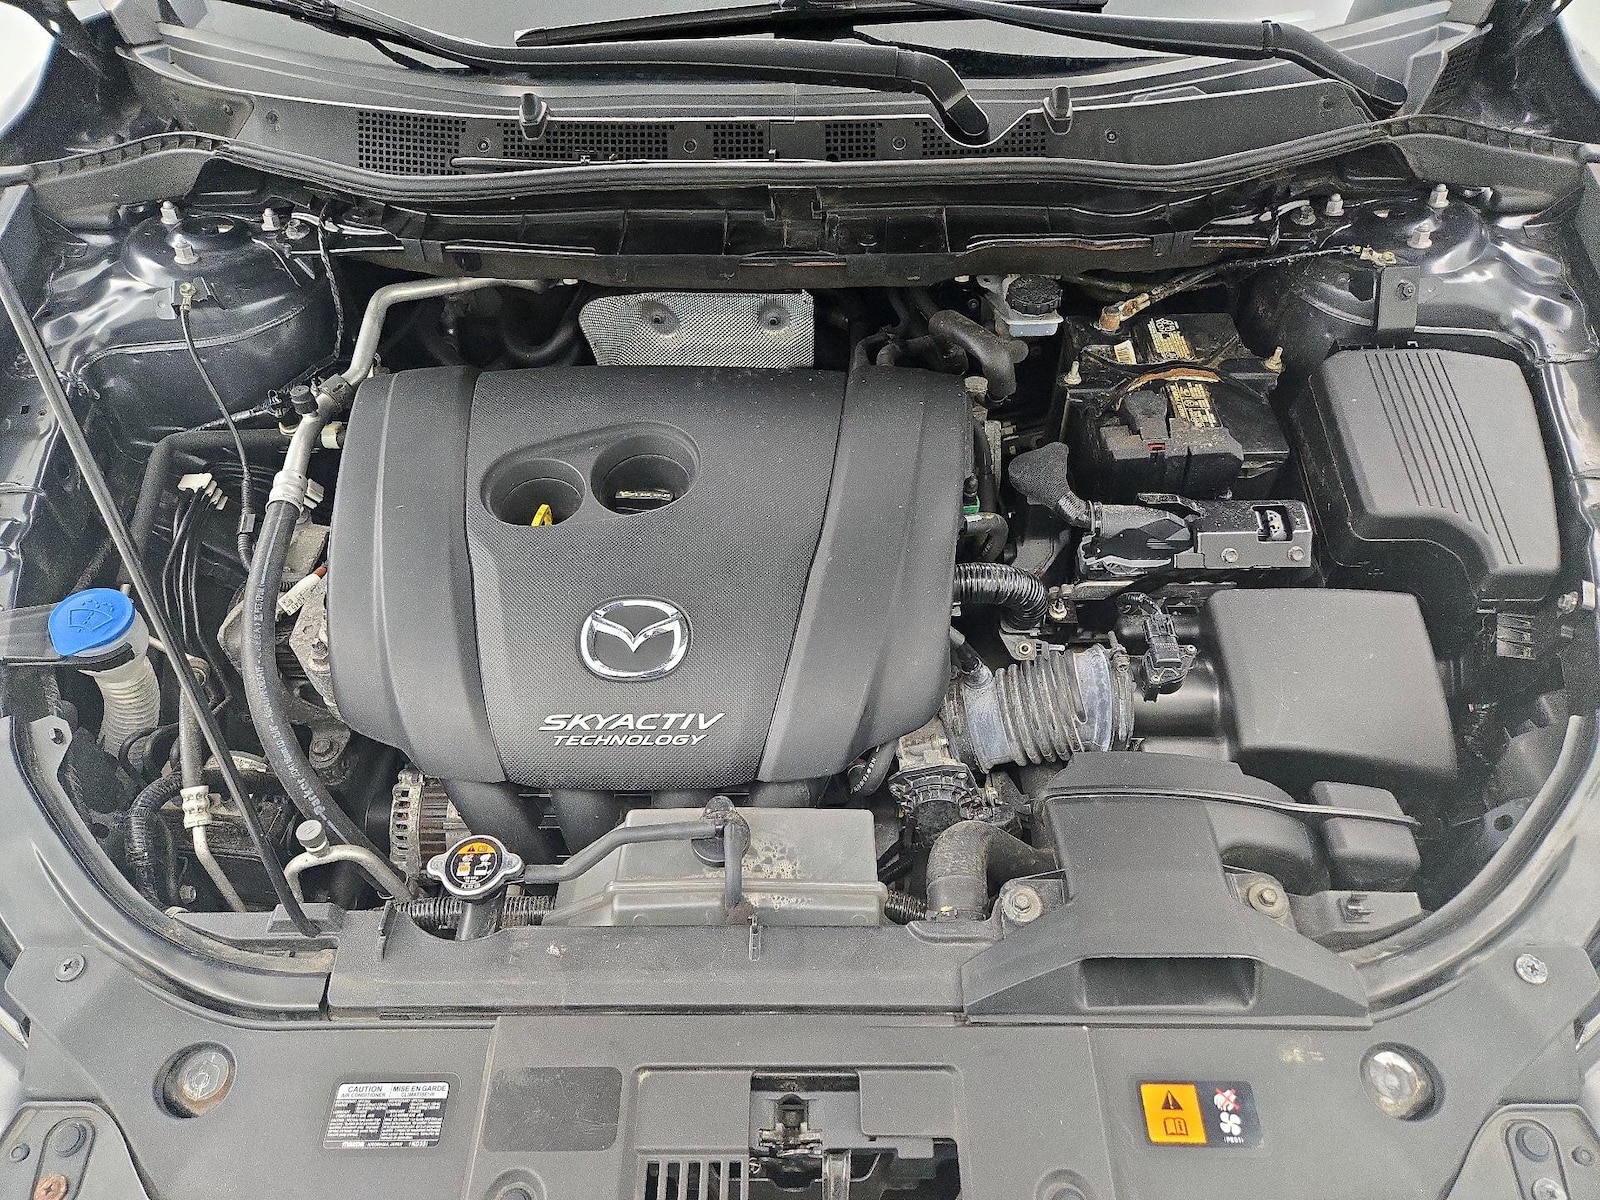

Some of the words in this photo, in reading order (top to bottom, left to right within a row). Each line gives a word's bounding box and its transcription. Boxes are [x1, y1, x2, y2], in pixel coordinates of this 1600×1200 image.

[538, 713, 725, 731] SKYACTIV
[553, 735, 708, 746] TECHNOLOGY
[297, 778, 326, 816] Parker
[347, 1085, 383, 1093] CAUTION
[420, 1084, 447, 1092] GARDE
